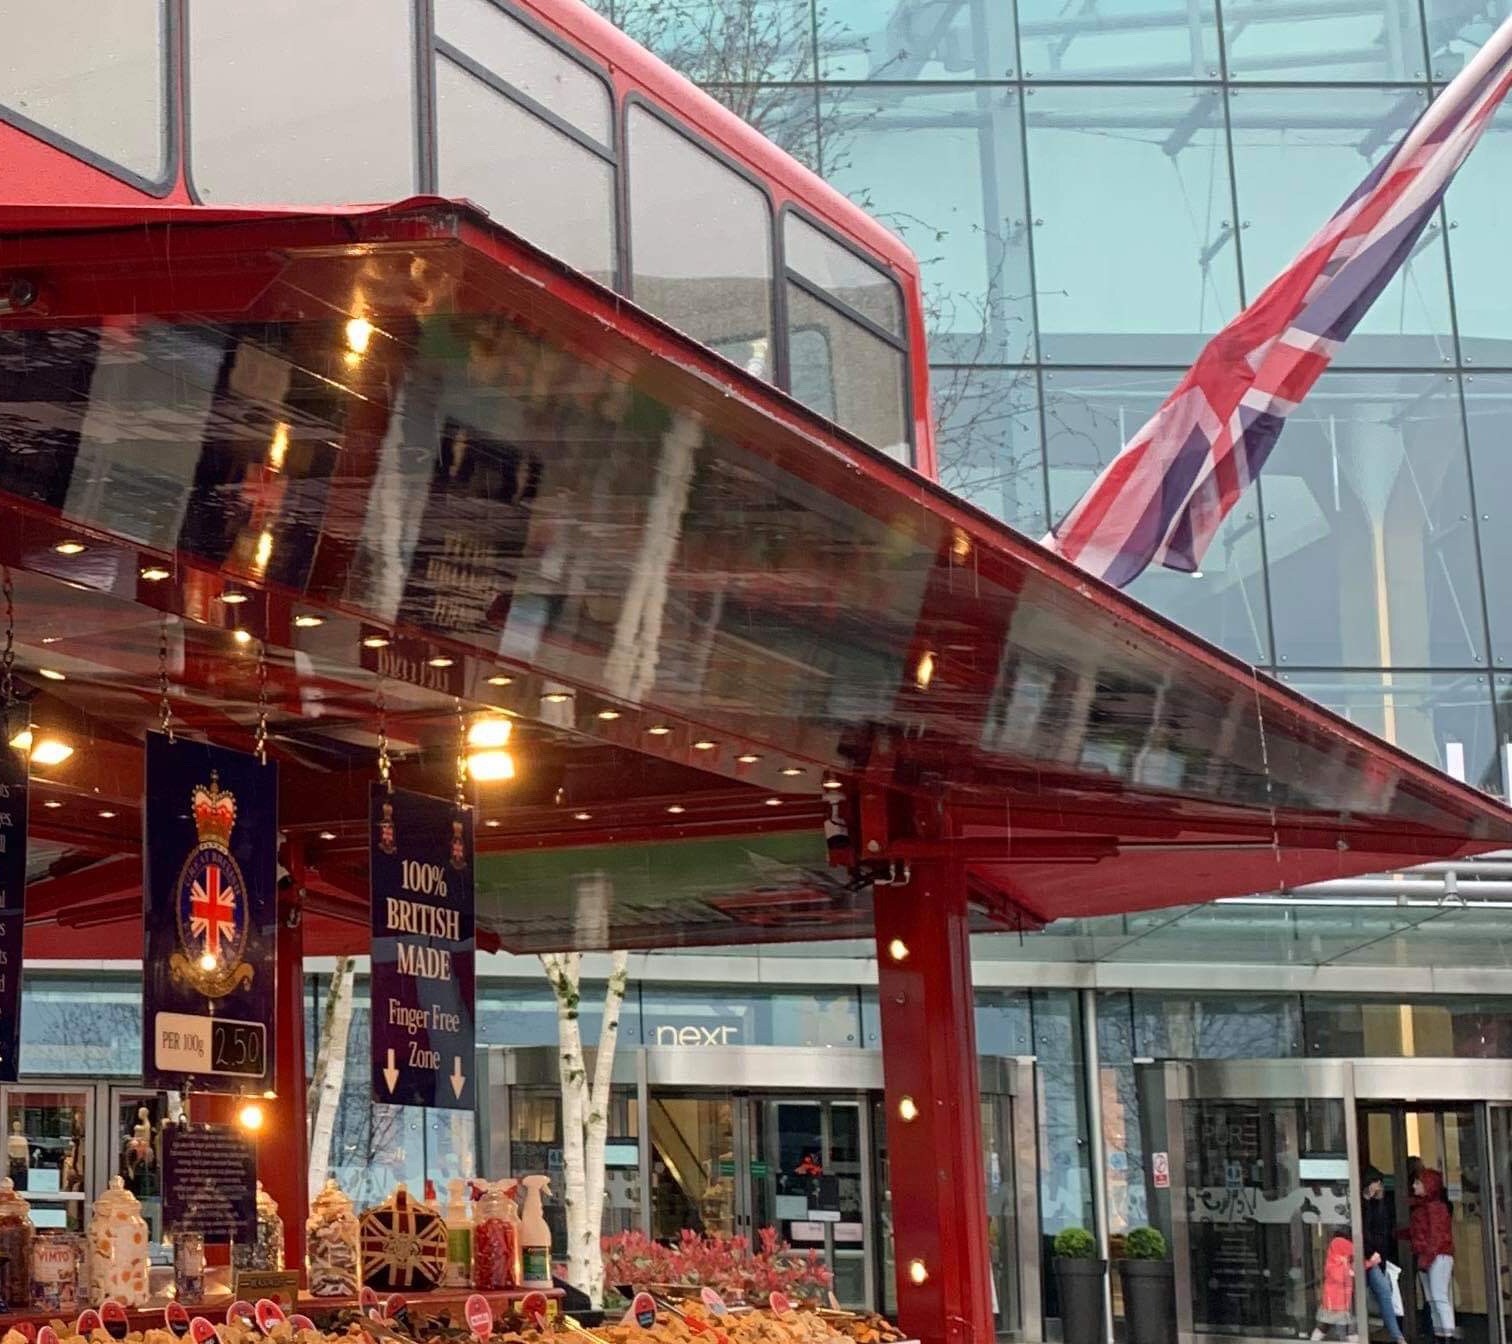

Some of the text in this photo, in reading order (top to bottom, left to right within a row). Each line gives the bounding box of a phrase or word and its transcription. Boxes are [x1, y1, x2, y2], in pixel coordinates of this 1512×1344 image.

[401, 859, 448, 897] 100%
[386, 897, 461, 941] BRITISH
[397, 942, 451, 982] MADE
[389, 998, 461, 1035] Finger Free
[656, 1023, 739, 1046] next
[162, 1031, 205, 1058] PER 100g
[215, 1027, 259, 1066] 2.50
[409, 1041, 441, 1070] Zone
[39, 1250, 72, 1263] VIMTO
